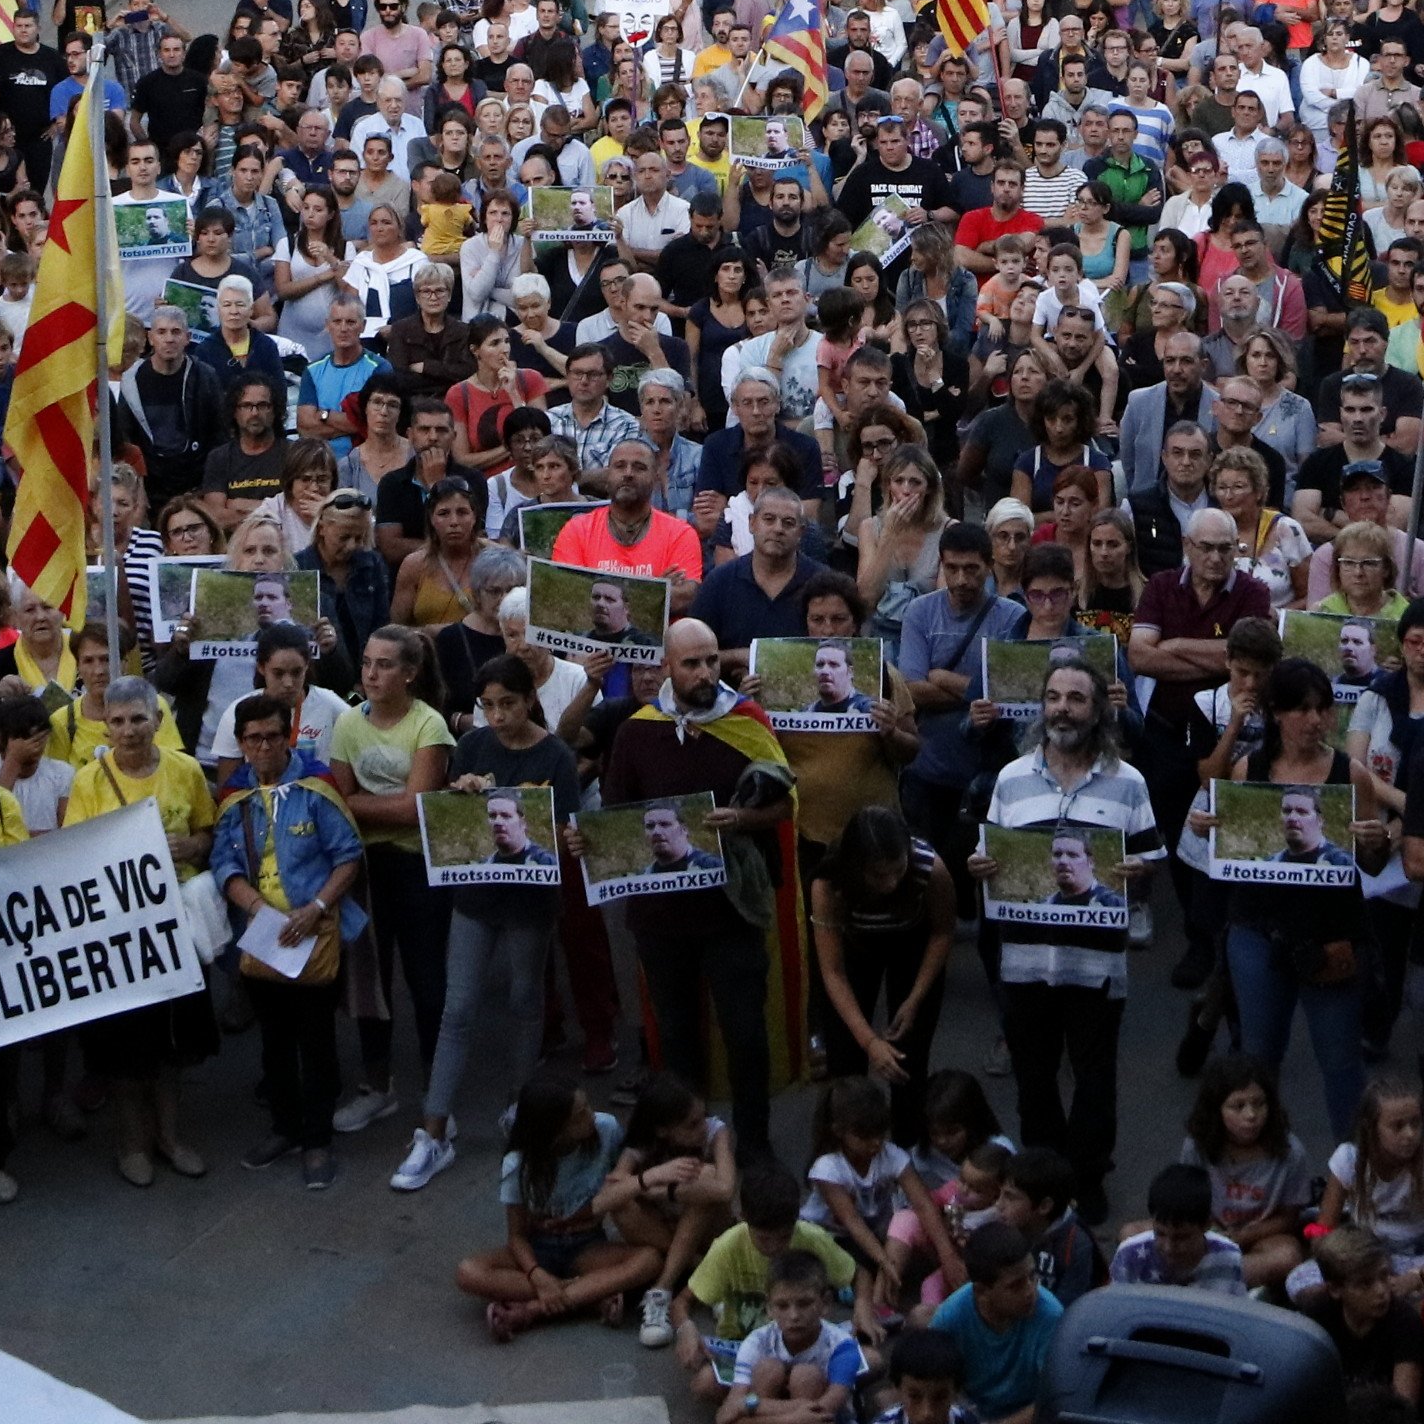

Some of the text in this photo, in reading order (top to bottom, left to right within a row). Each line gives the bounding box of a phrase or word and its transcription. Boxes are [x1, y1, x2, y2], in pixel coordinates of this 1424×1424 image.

[539, 232, 614, 241] #totssomTXEVI
[441, 869, 557, 883] #totssomTXEVI
[599, 869, 725, 899] #totssomTXEVI
[1222, 866, 1354, 884] #totssomTXEVI
[61, 879, 106, 926] DE
[105, 852, 167, 914] VIC
[998, 906, 1126, 925] #totssomTXEVI
